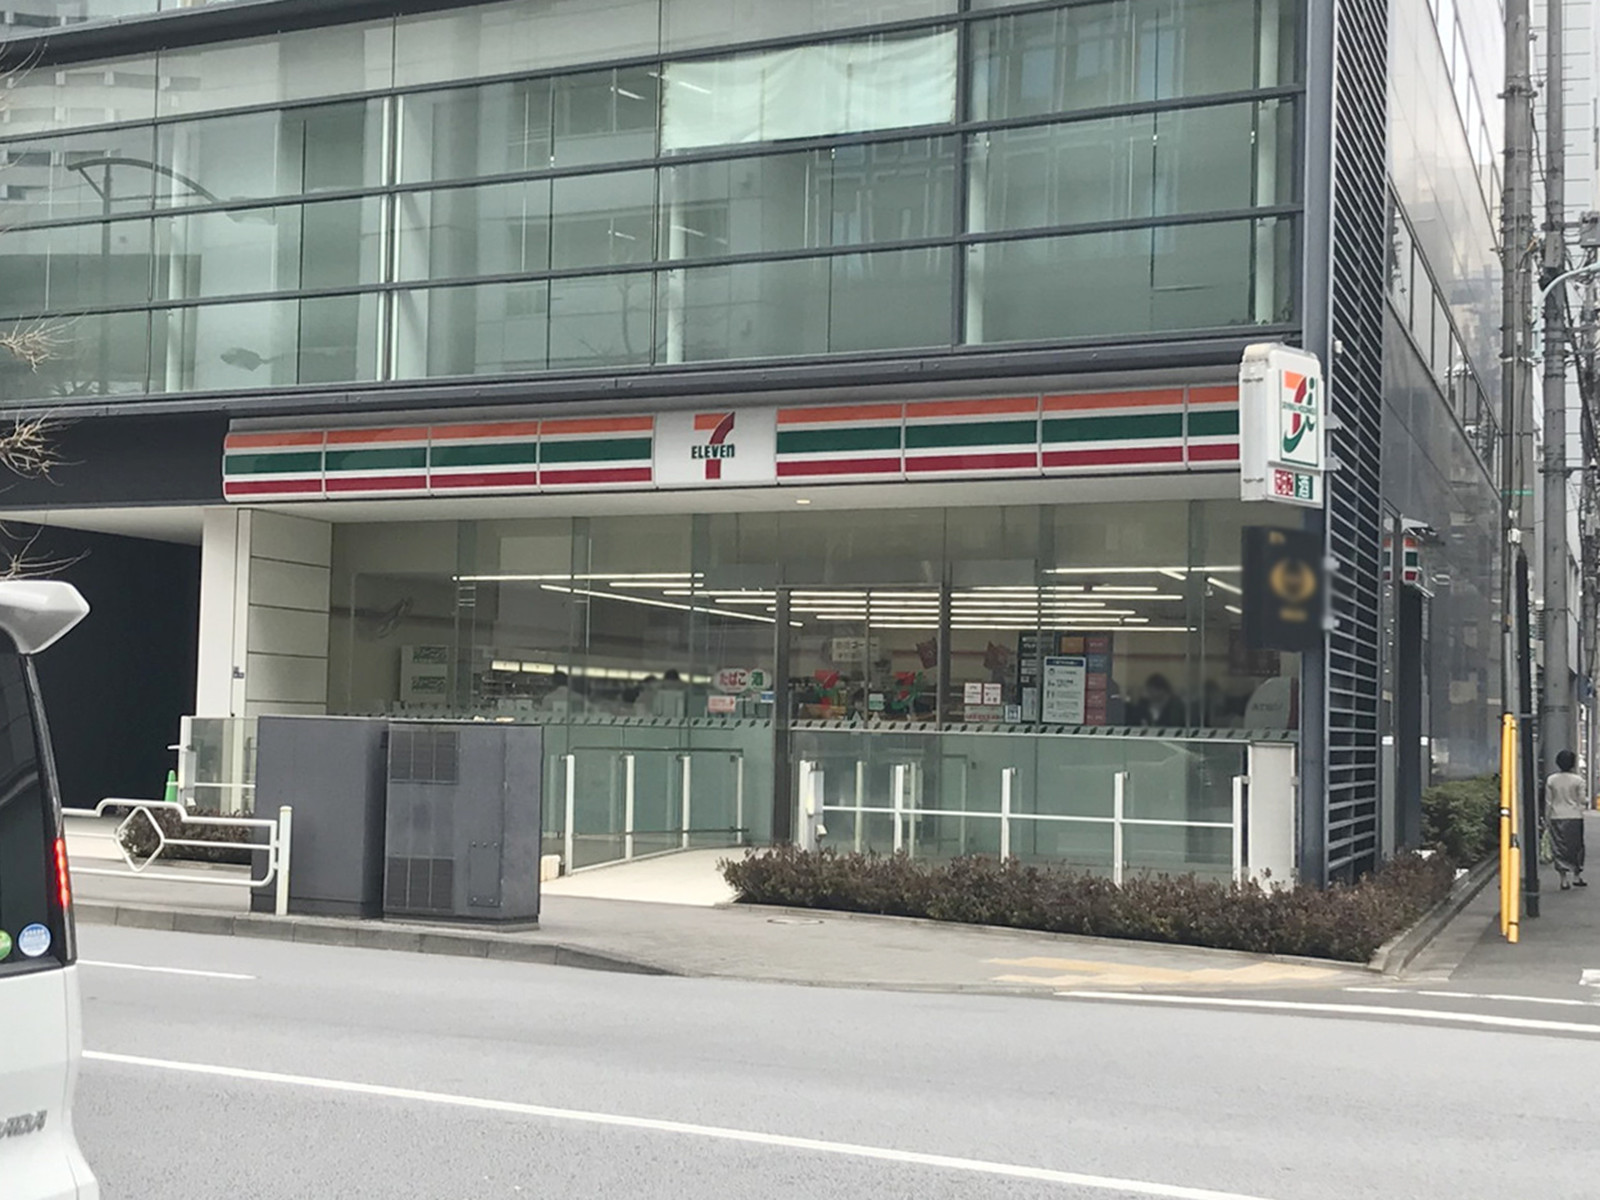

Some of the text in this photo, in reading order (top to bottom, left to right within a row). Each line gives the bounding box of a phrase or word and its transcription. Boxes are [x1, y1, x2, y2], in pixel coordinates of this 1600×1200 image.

[694, 411, 736, 480] 7
[719, 671, 746, 686] たばこ
